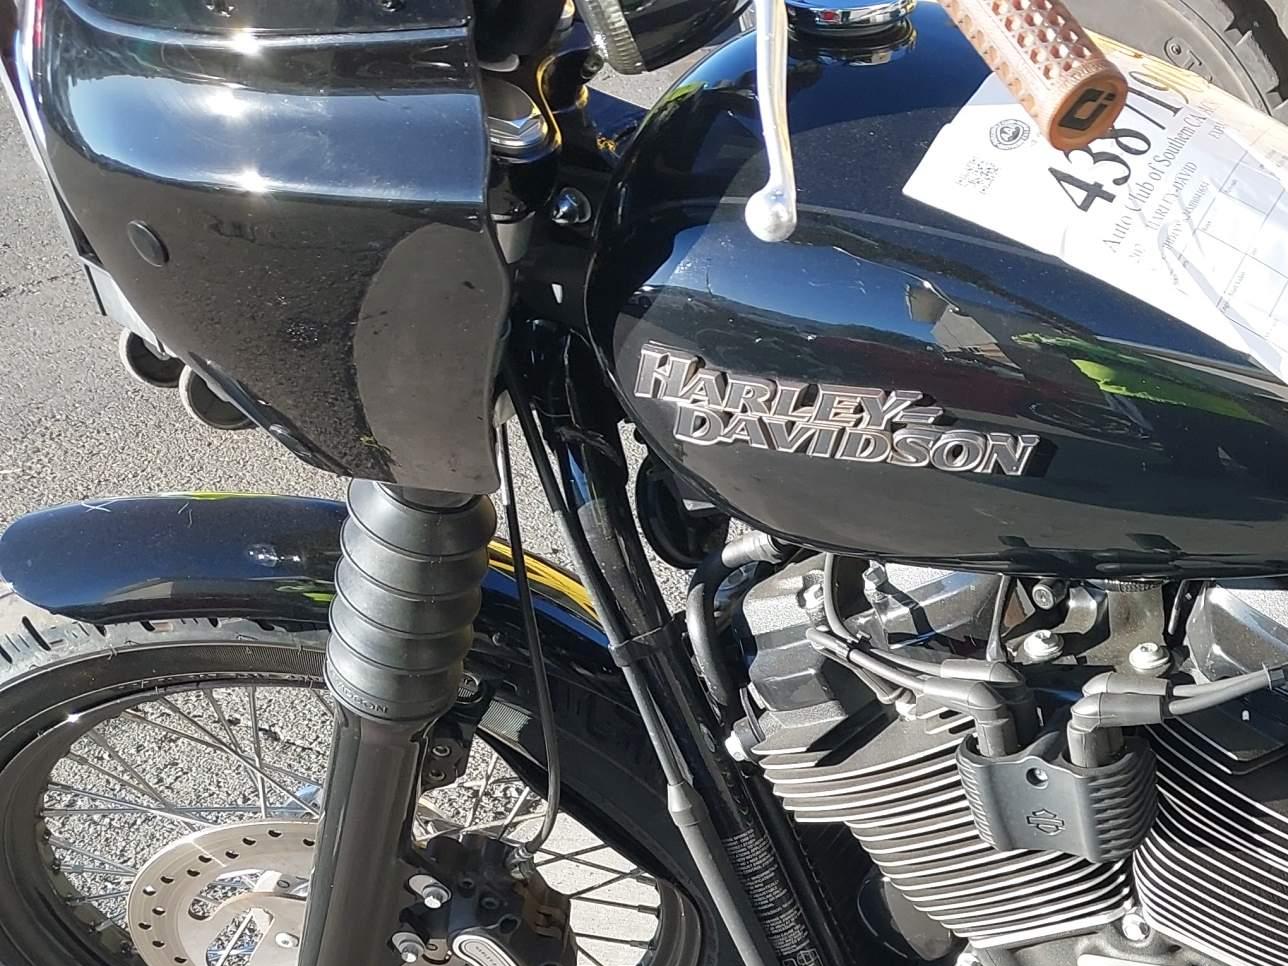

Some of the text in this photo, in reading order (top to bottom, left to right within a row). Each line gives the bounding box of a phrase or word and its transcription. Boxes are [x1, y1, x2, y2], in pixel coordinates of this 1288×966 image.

[1153, 125, 1195, 168] Southern
[1148, 161, 1165, 182] of
[1124, 181, 1155, 212] Club
[1102, 214, 1133, 253] Auto
[674, 402, 1040, 476] DAVIDSON
